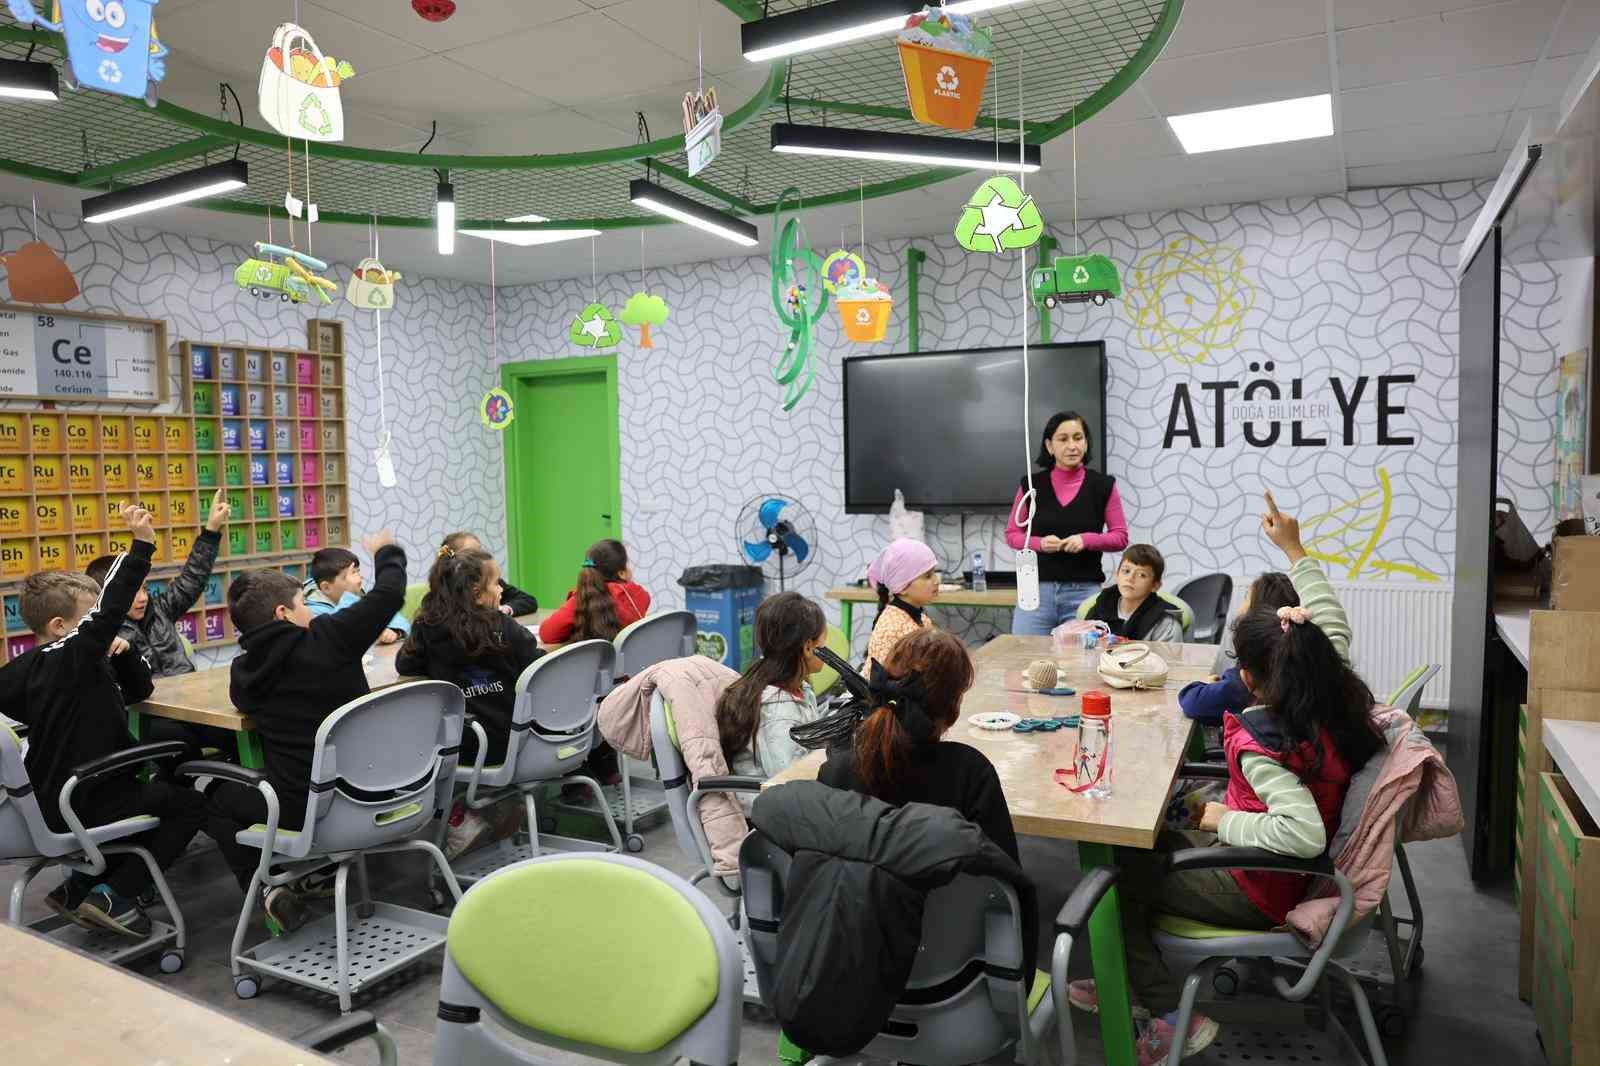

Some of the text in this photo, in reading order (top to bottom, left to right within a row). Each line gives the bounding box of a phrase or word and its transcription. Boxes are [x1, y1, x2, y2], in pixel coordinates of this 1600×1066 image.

[38, 315, 55, 328] 58
[3, 348, 18, 356] Gas
[52, 339, 92, 365] Ce
[194, 354, 202, 366] B
[222, 357, 229, 368] C
[247, 359, 256, 370] N
[272, 361, 281, 372] O
[298, 363, 305, 373] F
[54, 369, 92, 379] 140.116
[55, 385, 93, 395] Cerium
[193, 391, 206, 401] Al
[1163, 361, 1415, 449] ATÖLYE
[33, 424, 50, 437] Fe
[67, 425, 86, 437] Co
[103, 425, 119, 437] Ni
[134, 425, 151, 438] Cu
[165, 427, 181, 437] Zn
[0, 466, 15, 478] Tc
[34, 465, 54, 477] Ru
[70, 464, 89, 476] Rh
[104, 464, 121, 476] Pd
[137, 464, 153, 480] Ag
[167, 464, 183, 475] Cd
[326, 463, 335, 472] e
[326, 494, 336, 504] n
[0, 507, 19, 520] Re
[37, 505, 57, 518] Os
[77, 503, 88, 516] Ir
[40, 546, 60, 558] Hs
[76, 542, 95, 554] Mt
[110, 541, 127, 552] Ds
[1, 547, 23, 561] Bh
